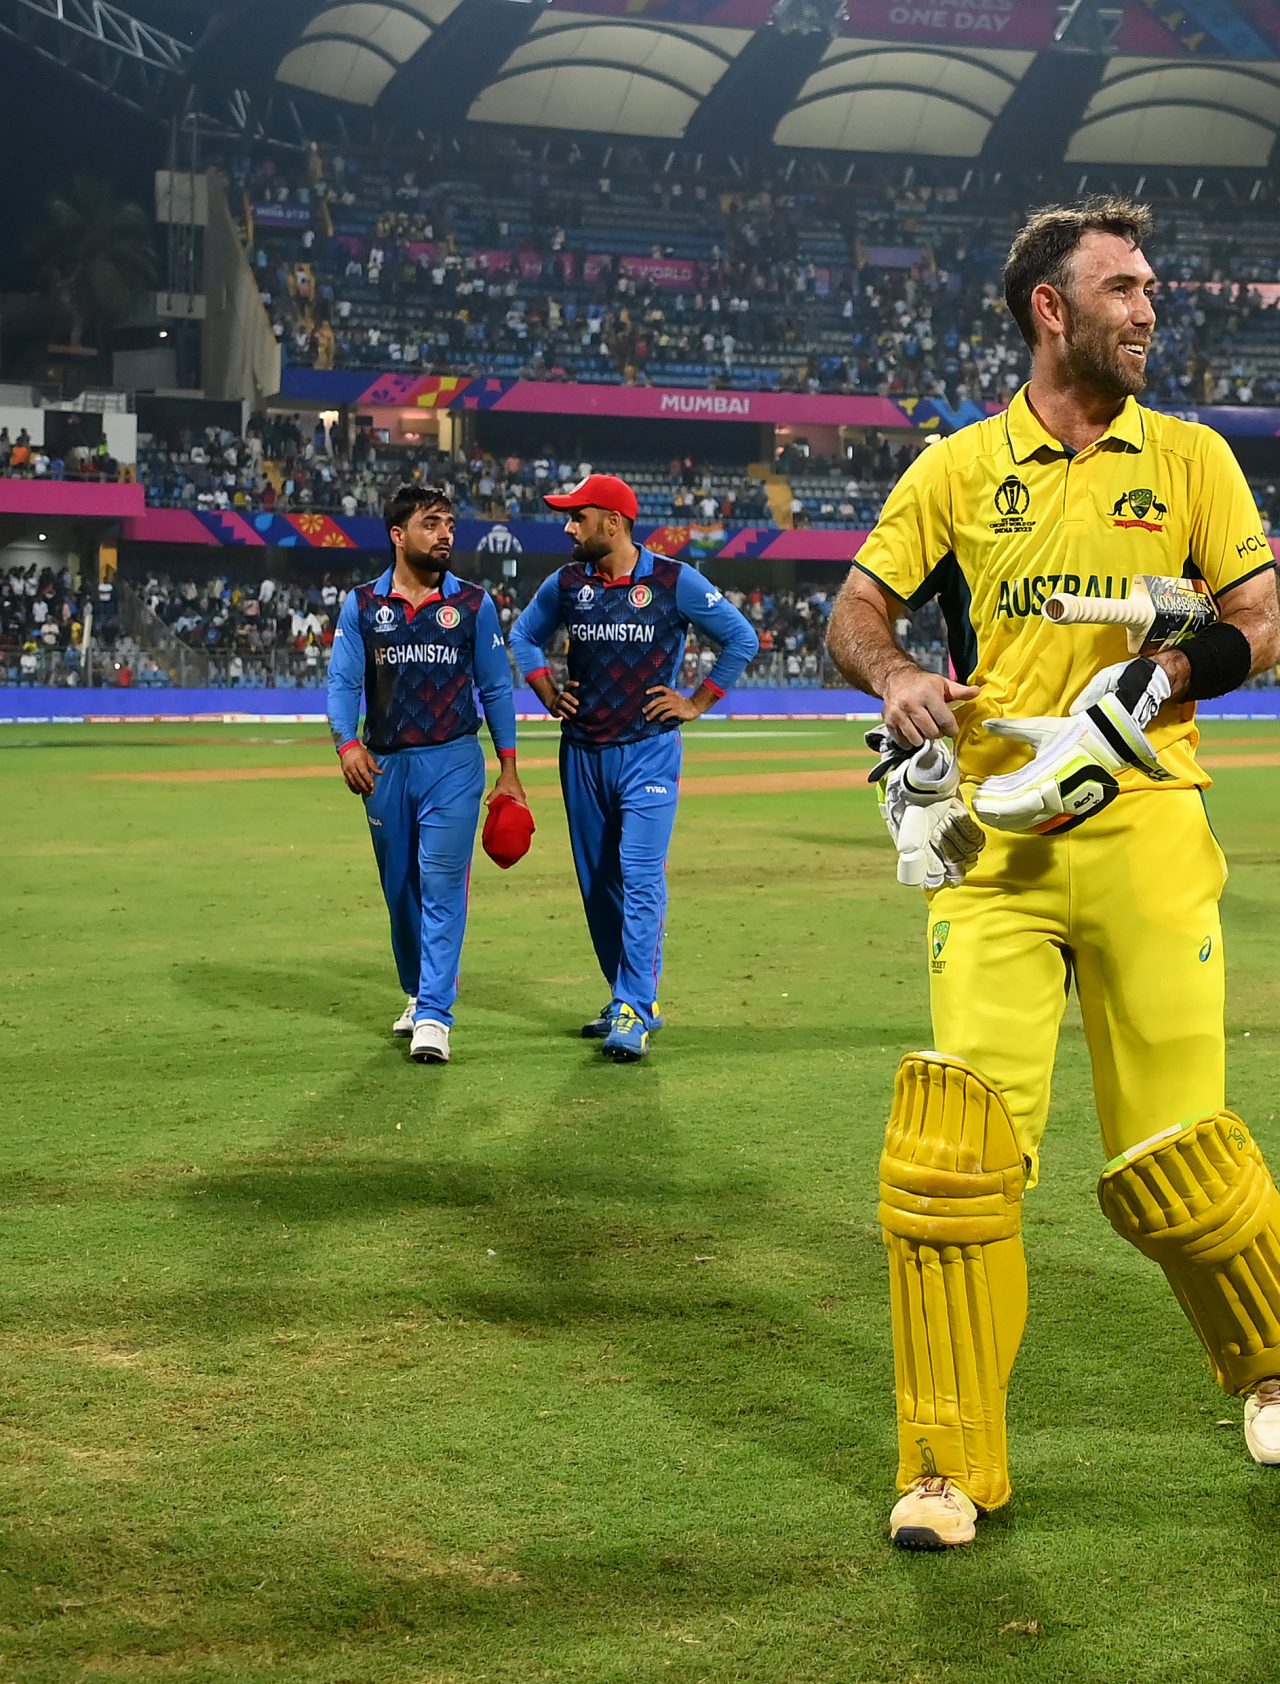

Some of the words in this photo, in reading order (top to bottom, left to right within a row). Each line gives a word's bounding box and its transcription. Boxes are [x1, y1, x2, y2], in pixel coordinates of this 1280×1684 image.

[888, 7, 947, 27] ONE
[954, 11, 1010, 32] DAY
[660, 394, 750, 415] MUMBAI
[1235, 532, 1266, 559] HCL
[568, 623, 655, 643] FGHANISTAN
[374, 644, 459, 665] AFGHANISTAN
